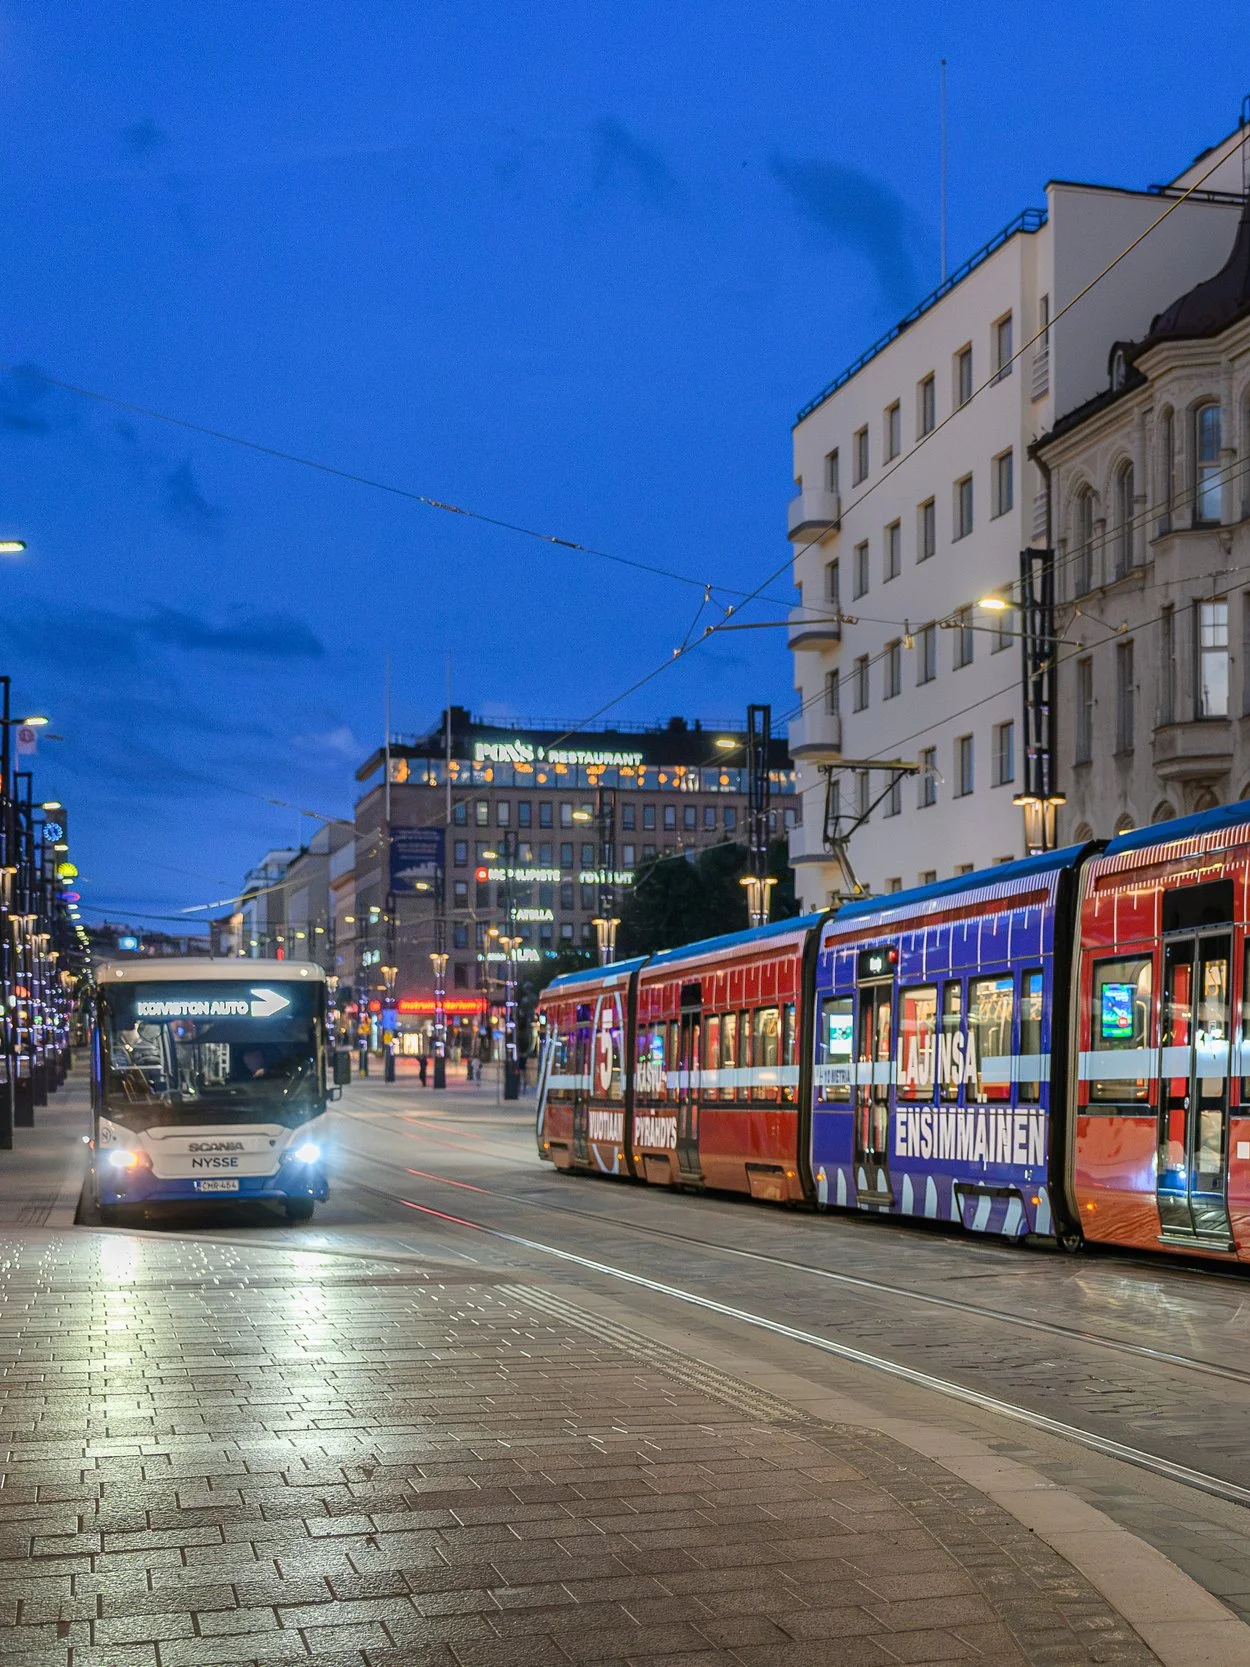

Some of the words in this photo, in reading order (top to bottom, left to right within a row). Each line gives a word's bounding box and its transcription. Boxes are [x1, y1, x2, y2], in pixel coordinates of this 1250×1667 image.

[548, 749, 644, 766] RESTAURANT
[210, 1001, 249, 1016] AUTO
[600, 1008, 613, 1091] 5
[897, 1030, 978, 1087] LAJINSA
[633, 1108, 678, 1150] PYRÄHDYS
[895, 1093, 1046, 1167] ENSIMMÄINEN
[188, 1141, 245, 1153] SCANIA
[192, 1156, 239, 1169] NYSSE
